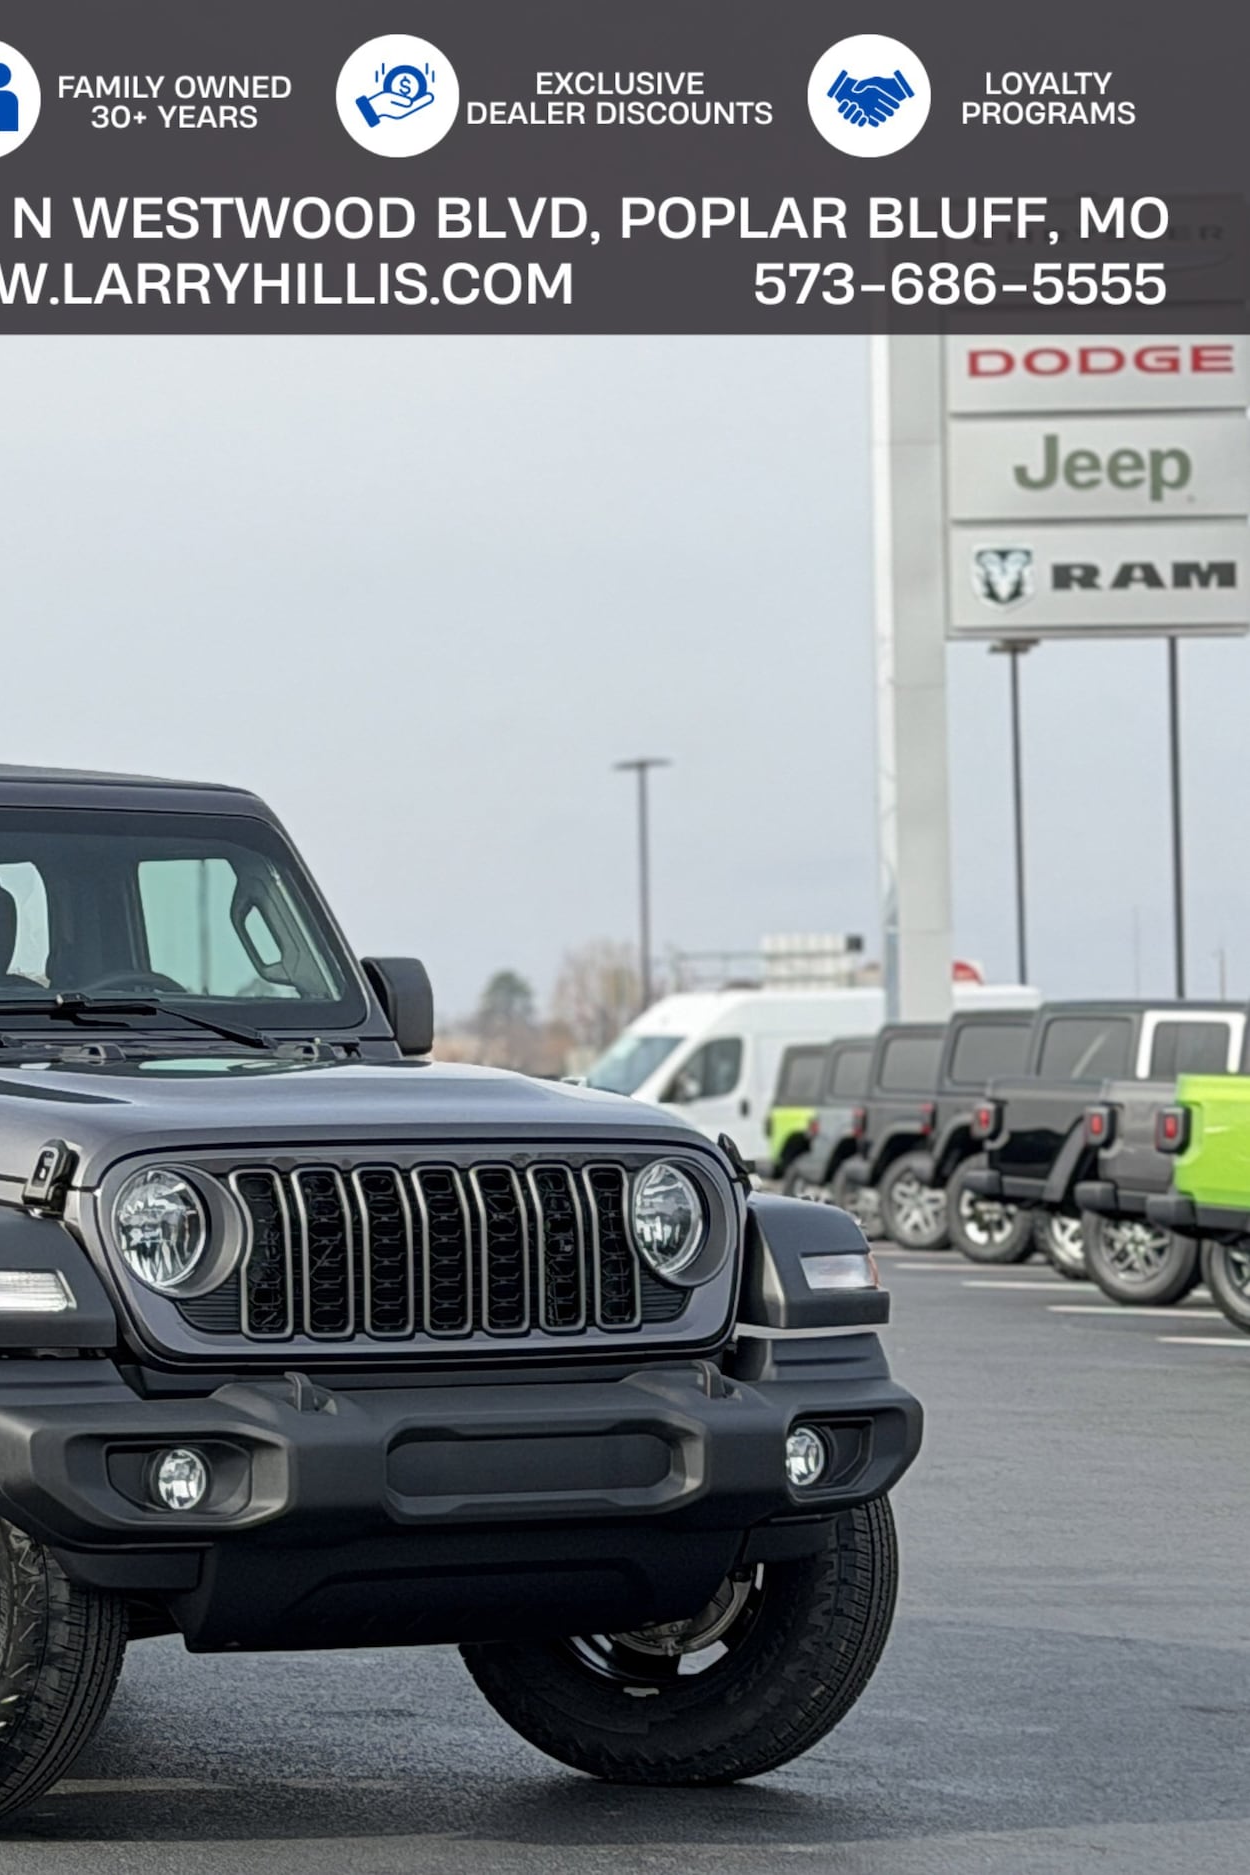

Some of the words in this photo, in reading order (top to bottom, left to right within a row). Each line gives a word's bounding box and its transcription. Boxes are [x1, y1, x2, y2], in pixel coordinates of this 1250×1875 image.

[967, 344, 1235, 378] DODGE
[1013, 434, 1193, 503] Jeep
[1051, 561, 1238, 591] RAM
